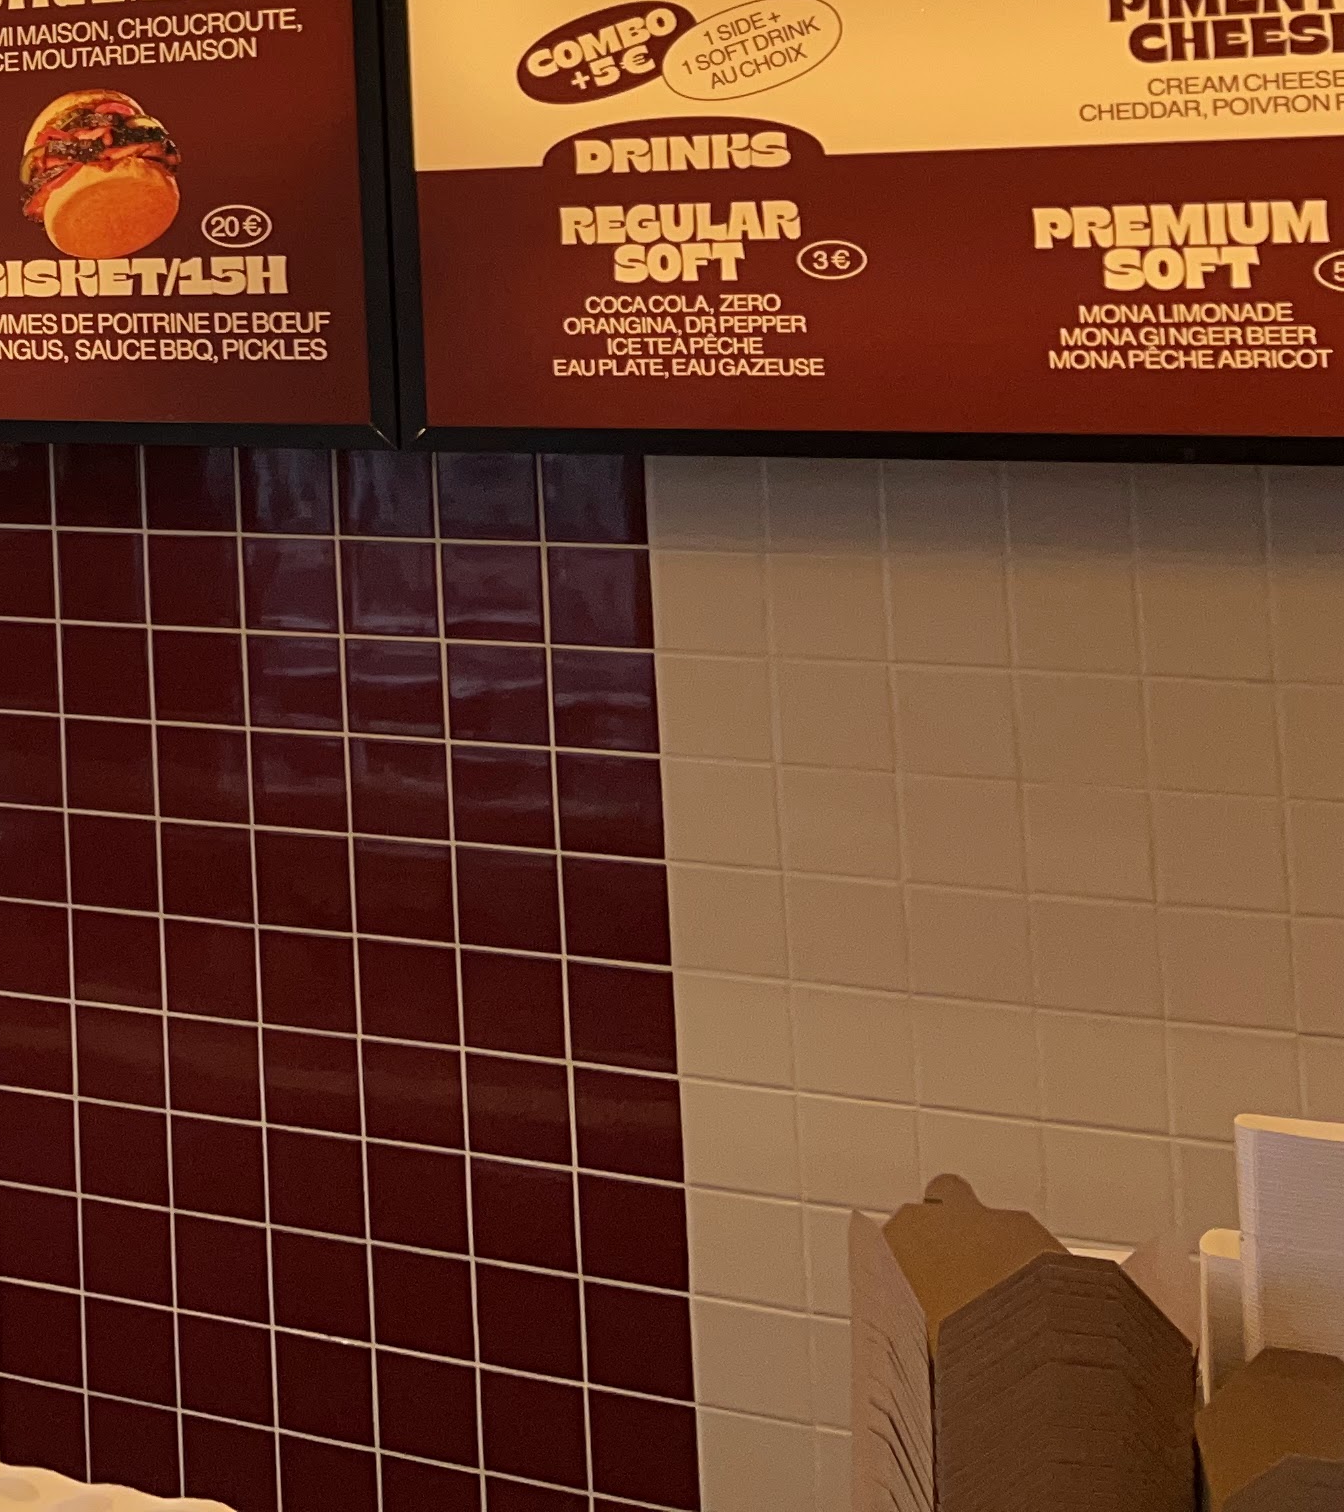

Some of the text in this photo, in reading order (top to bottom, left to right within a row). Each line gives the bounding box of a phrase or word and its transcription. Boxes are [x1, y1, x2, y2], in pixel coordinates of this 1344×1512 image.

[16, 20, 114, 47] MAISON,
[117, 7, 303, 40] CHOUCROUTE,
[22, 42, 157, 72] MOUTARDE
[158, 36, 258, 64] MAISON
[526, 8, 677, 78] COMBO
[574, 131, 792, 175] DRINKS
[559, 199, 802, 245] REGULAR
[1031, 199, 1331, 250] PREMIUM
[613, 241, 746, 284] SOFT
[1103, 245, 1260, 291] SOFT
[584, 293, 782, 315] COCA COLA, ZERO
[1078, 302, 1295, 324] MONA LIMONADE
[60, 313, 95, 335] DE
[97, 312, 211, 335] POITRINE
[213, 311, 250, 334] DE
[251, 311, 331, 334] BŒUF
[563, 314, 808, 337] ORANGINA, DR PEPPER
[74, 338, 158, 361] SAUCE
[159, 338, 219, 364] BBQ,
[221, 338, 328, 361] PICKLES
[606, 332, 765, 356] ICE TEA PÊCHE
[1048, 345, 1334, 370] MONA PÊCHE ABRICOT
[552, 357, 826, 380] EAU PLATE, EAU GAZEUSE
